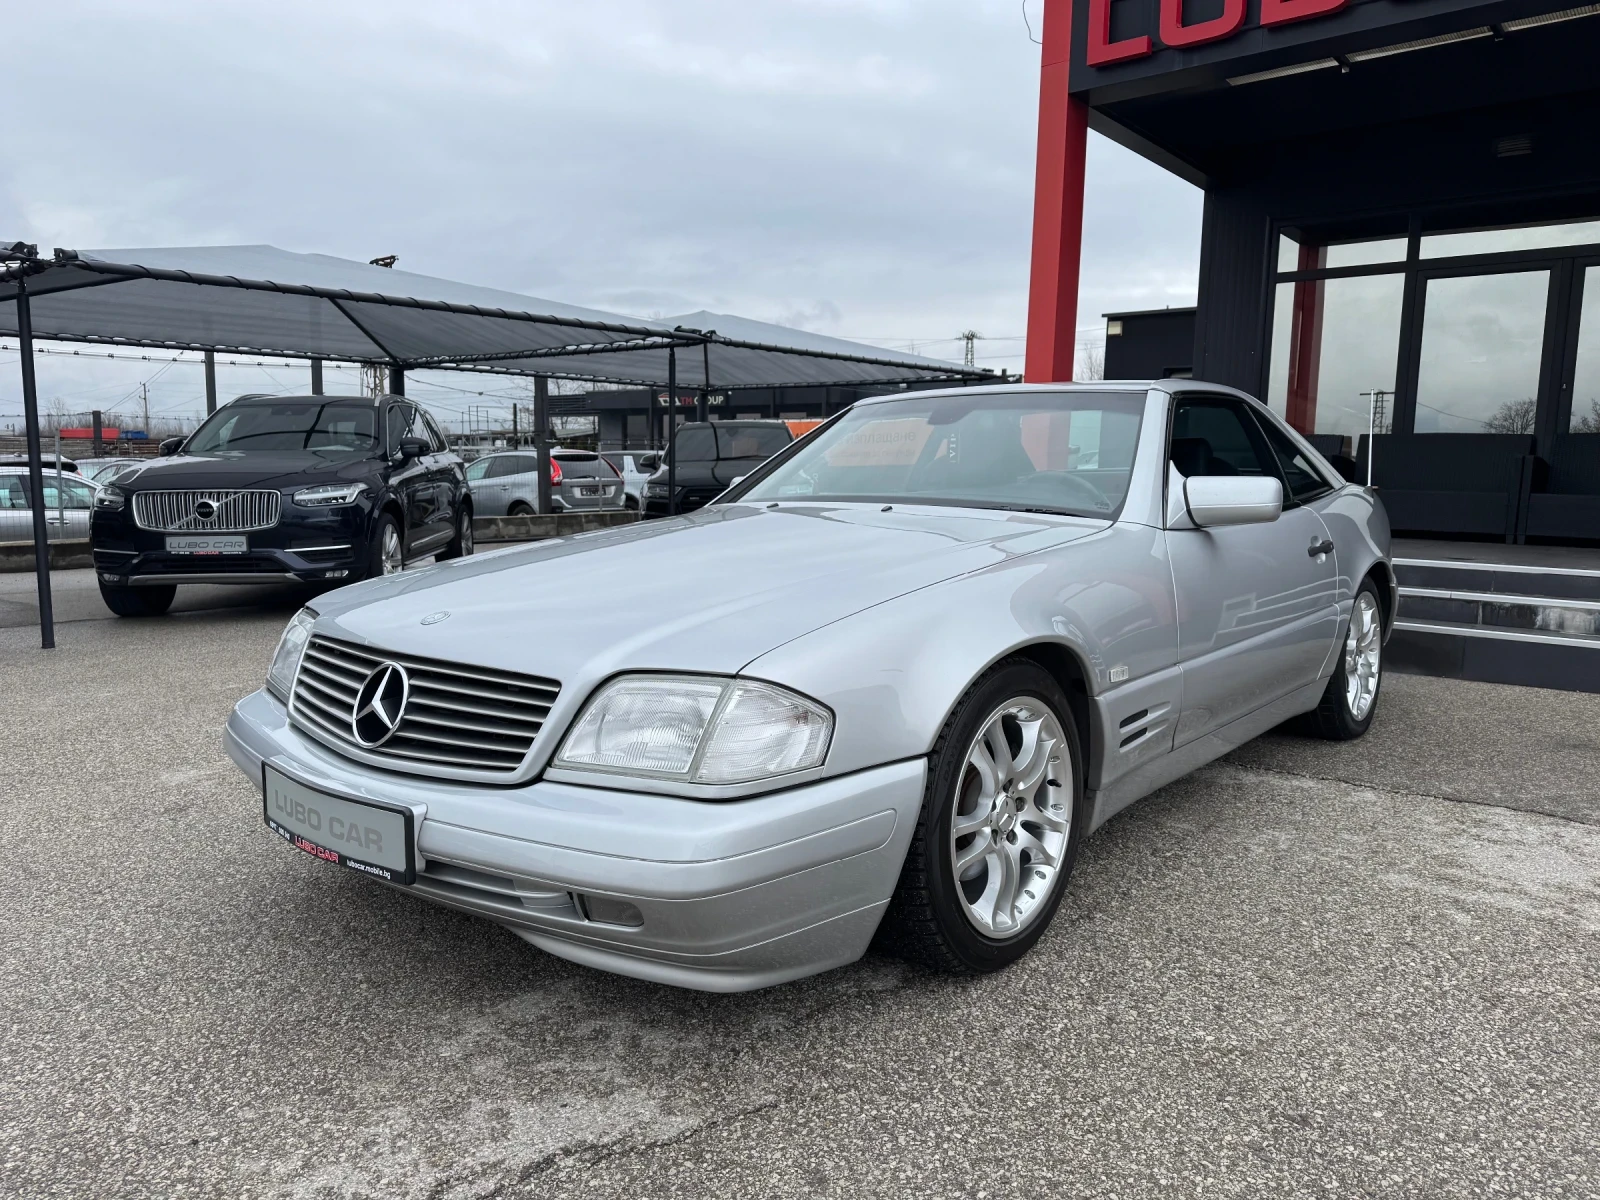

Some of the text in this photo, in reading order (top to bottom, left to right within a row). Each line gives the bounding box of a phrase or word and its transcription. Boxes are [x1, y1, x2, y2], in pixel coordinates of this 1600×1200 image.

[169, 541, 244, 549] LUBO CAR
[274, 789, 322, 832] LUBO
[329, 816, 383, 853] CAR
[294, 834, 339, 864] LUBO CAR
[346, 859, 391, 880] lubocar.mobile.bg
